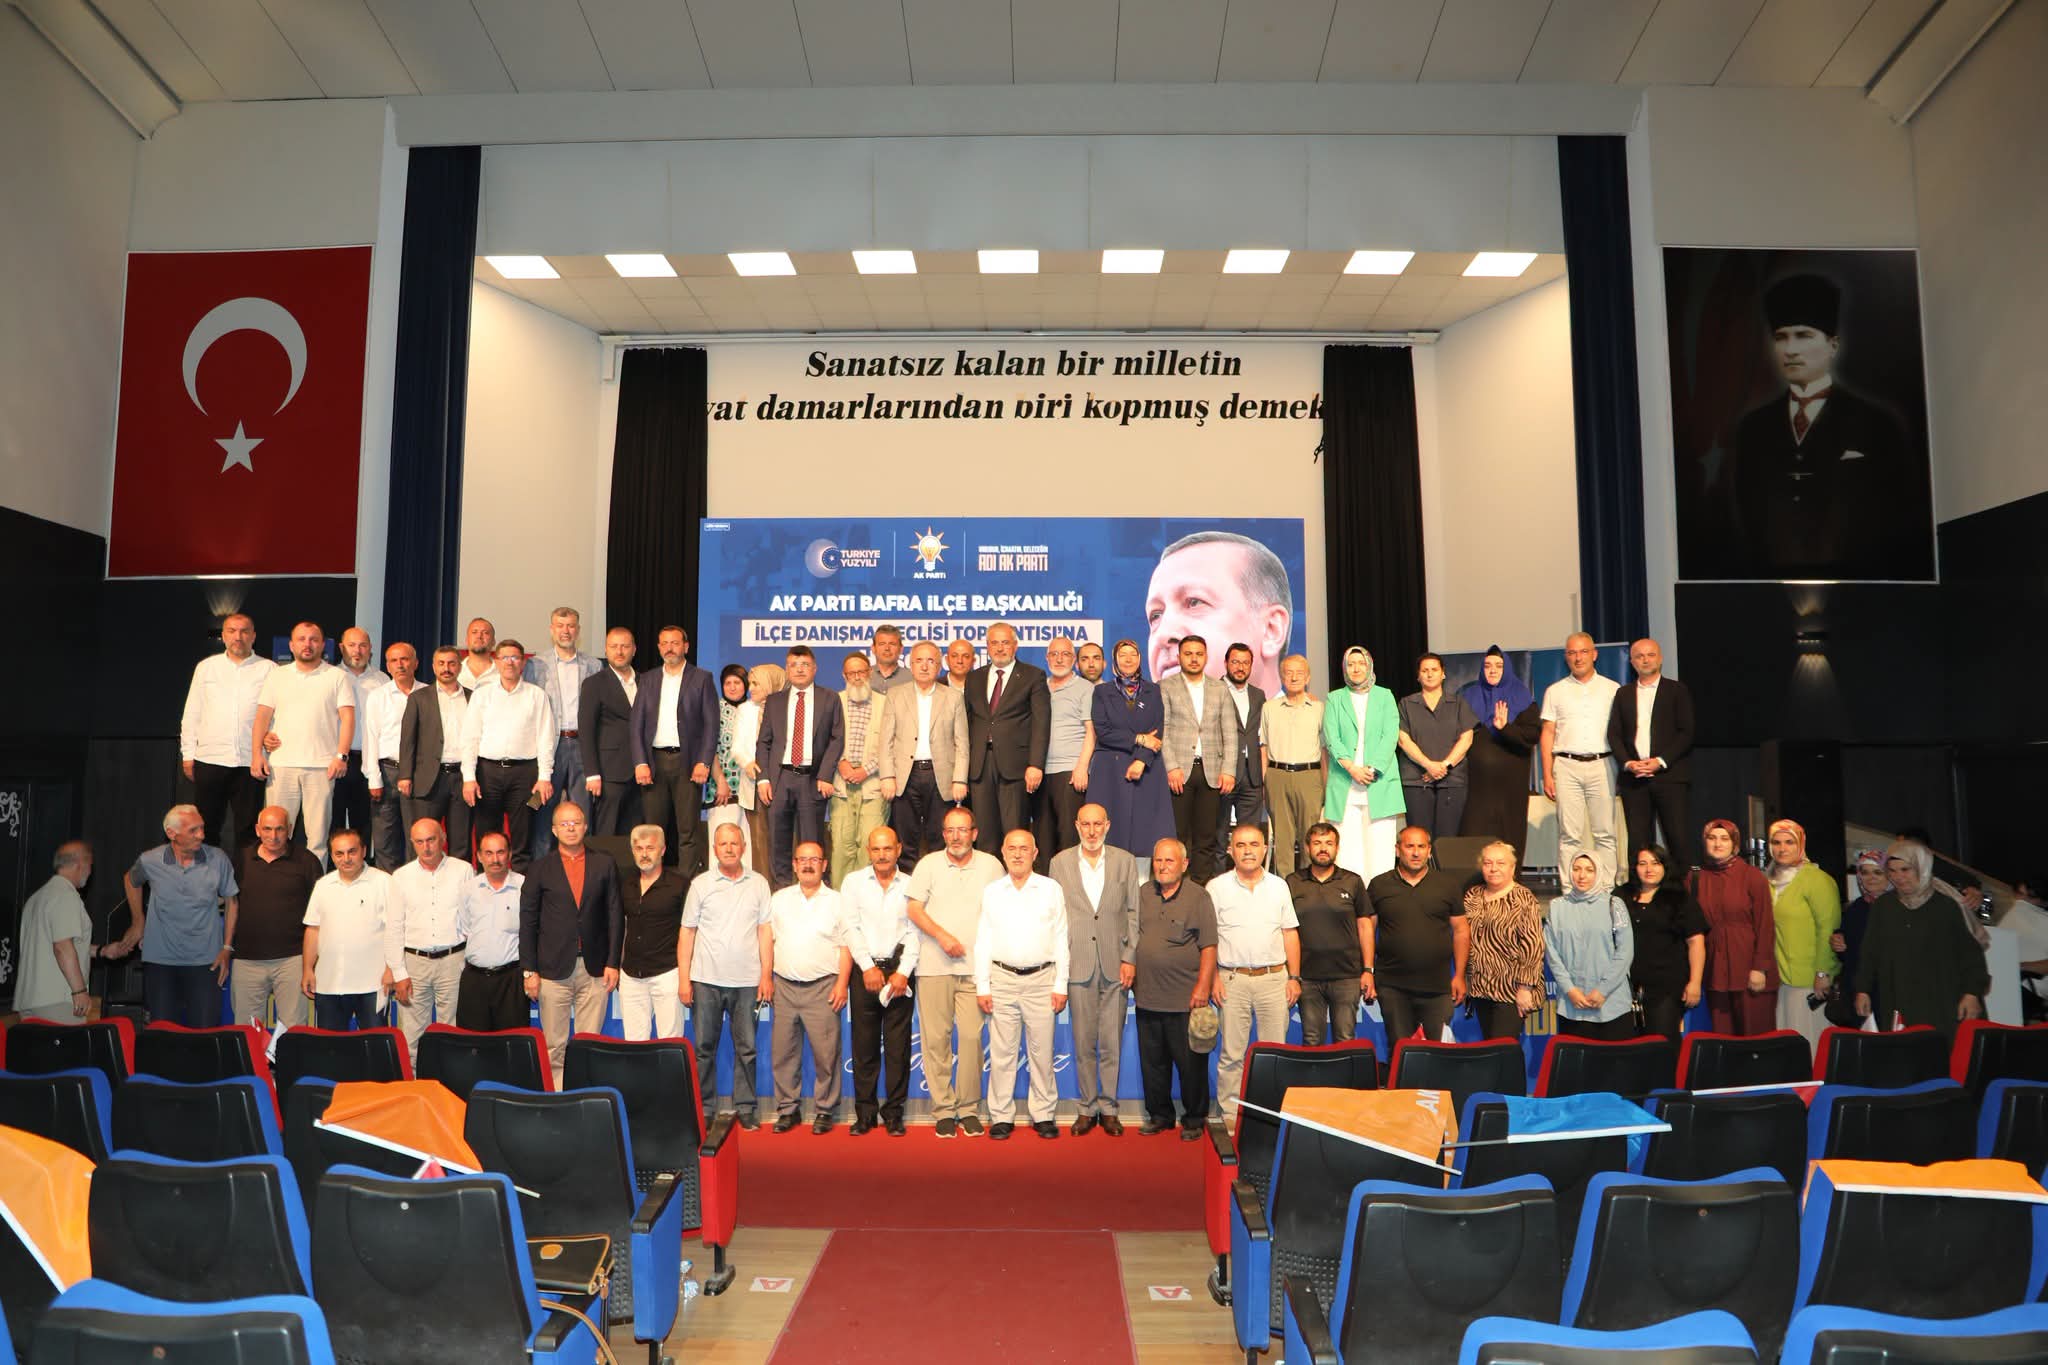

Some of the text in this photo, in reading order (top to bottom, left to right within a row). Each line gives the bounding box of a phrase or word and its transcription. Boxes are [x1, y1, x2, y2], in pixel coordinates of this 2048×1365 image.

[805, 349, 1242, 377] Sanatsız kalan bir milletin
[756, 392, 1004, 421] damarlarından
[1014, 392, 1073, 419] biri
[1081, 391, 1210, 427] kopmuş
[978, 553, 997, 571] ADI
[999, 553, 1014, 571] AK
[769, 594, 797, 612] AK
[859, 594, 924, 612] BAFRA
[971, 590, 1083, 617] BAŞKANLIĞI
[755, 622, 1089, 644] İLÇE DANIŞMA ECLİSİ TOPNTISI'NA
